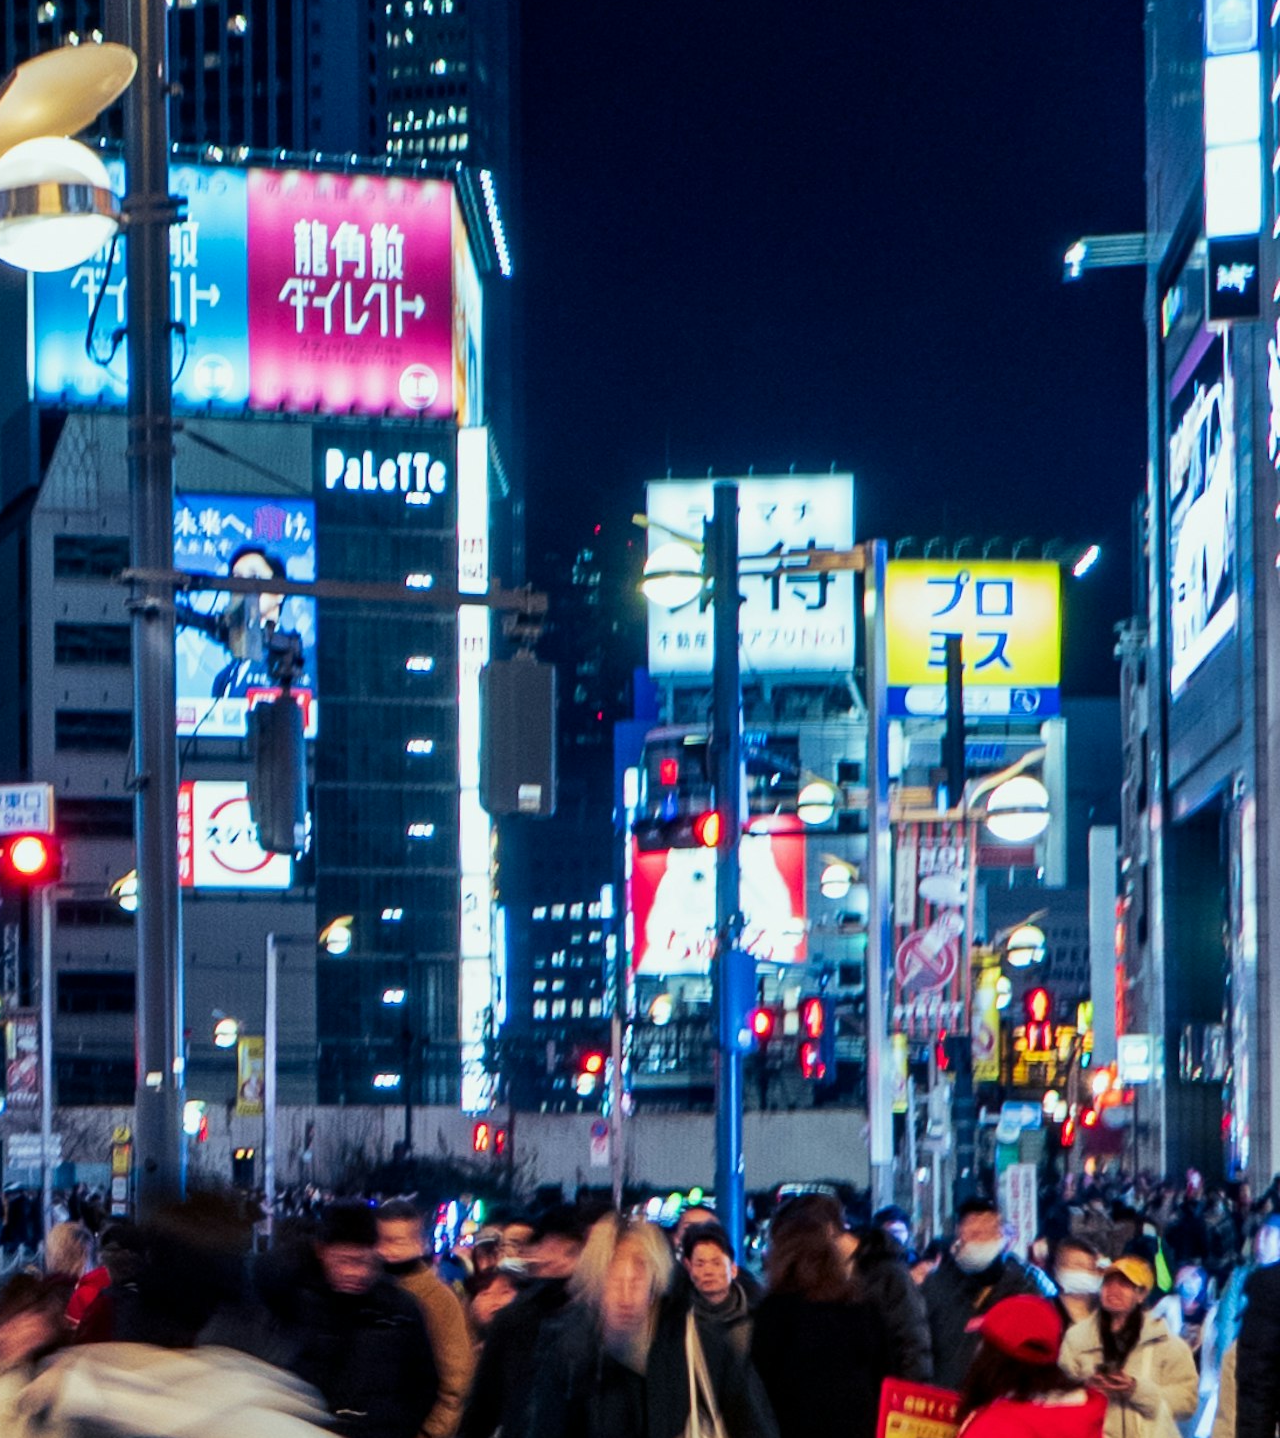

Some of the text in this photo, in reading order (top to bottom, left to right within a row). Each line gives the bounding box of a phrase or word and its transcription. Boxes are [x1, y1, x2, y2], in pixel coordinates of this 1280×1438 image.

[293, 218, 404, 279] 龍角散
[70, 267, 220, 327] ダイト
[278, 278, 426, 338] ダイレクト
[688, 500, 810, 524] ラマチ
[927, 570, 1013, 617] プロ
